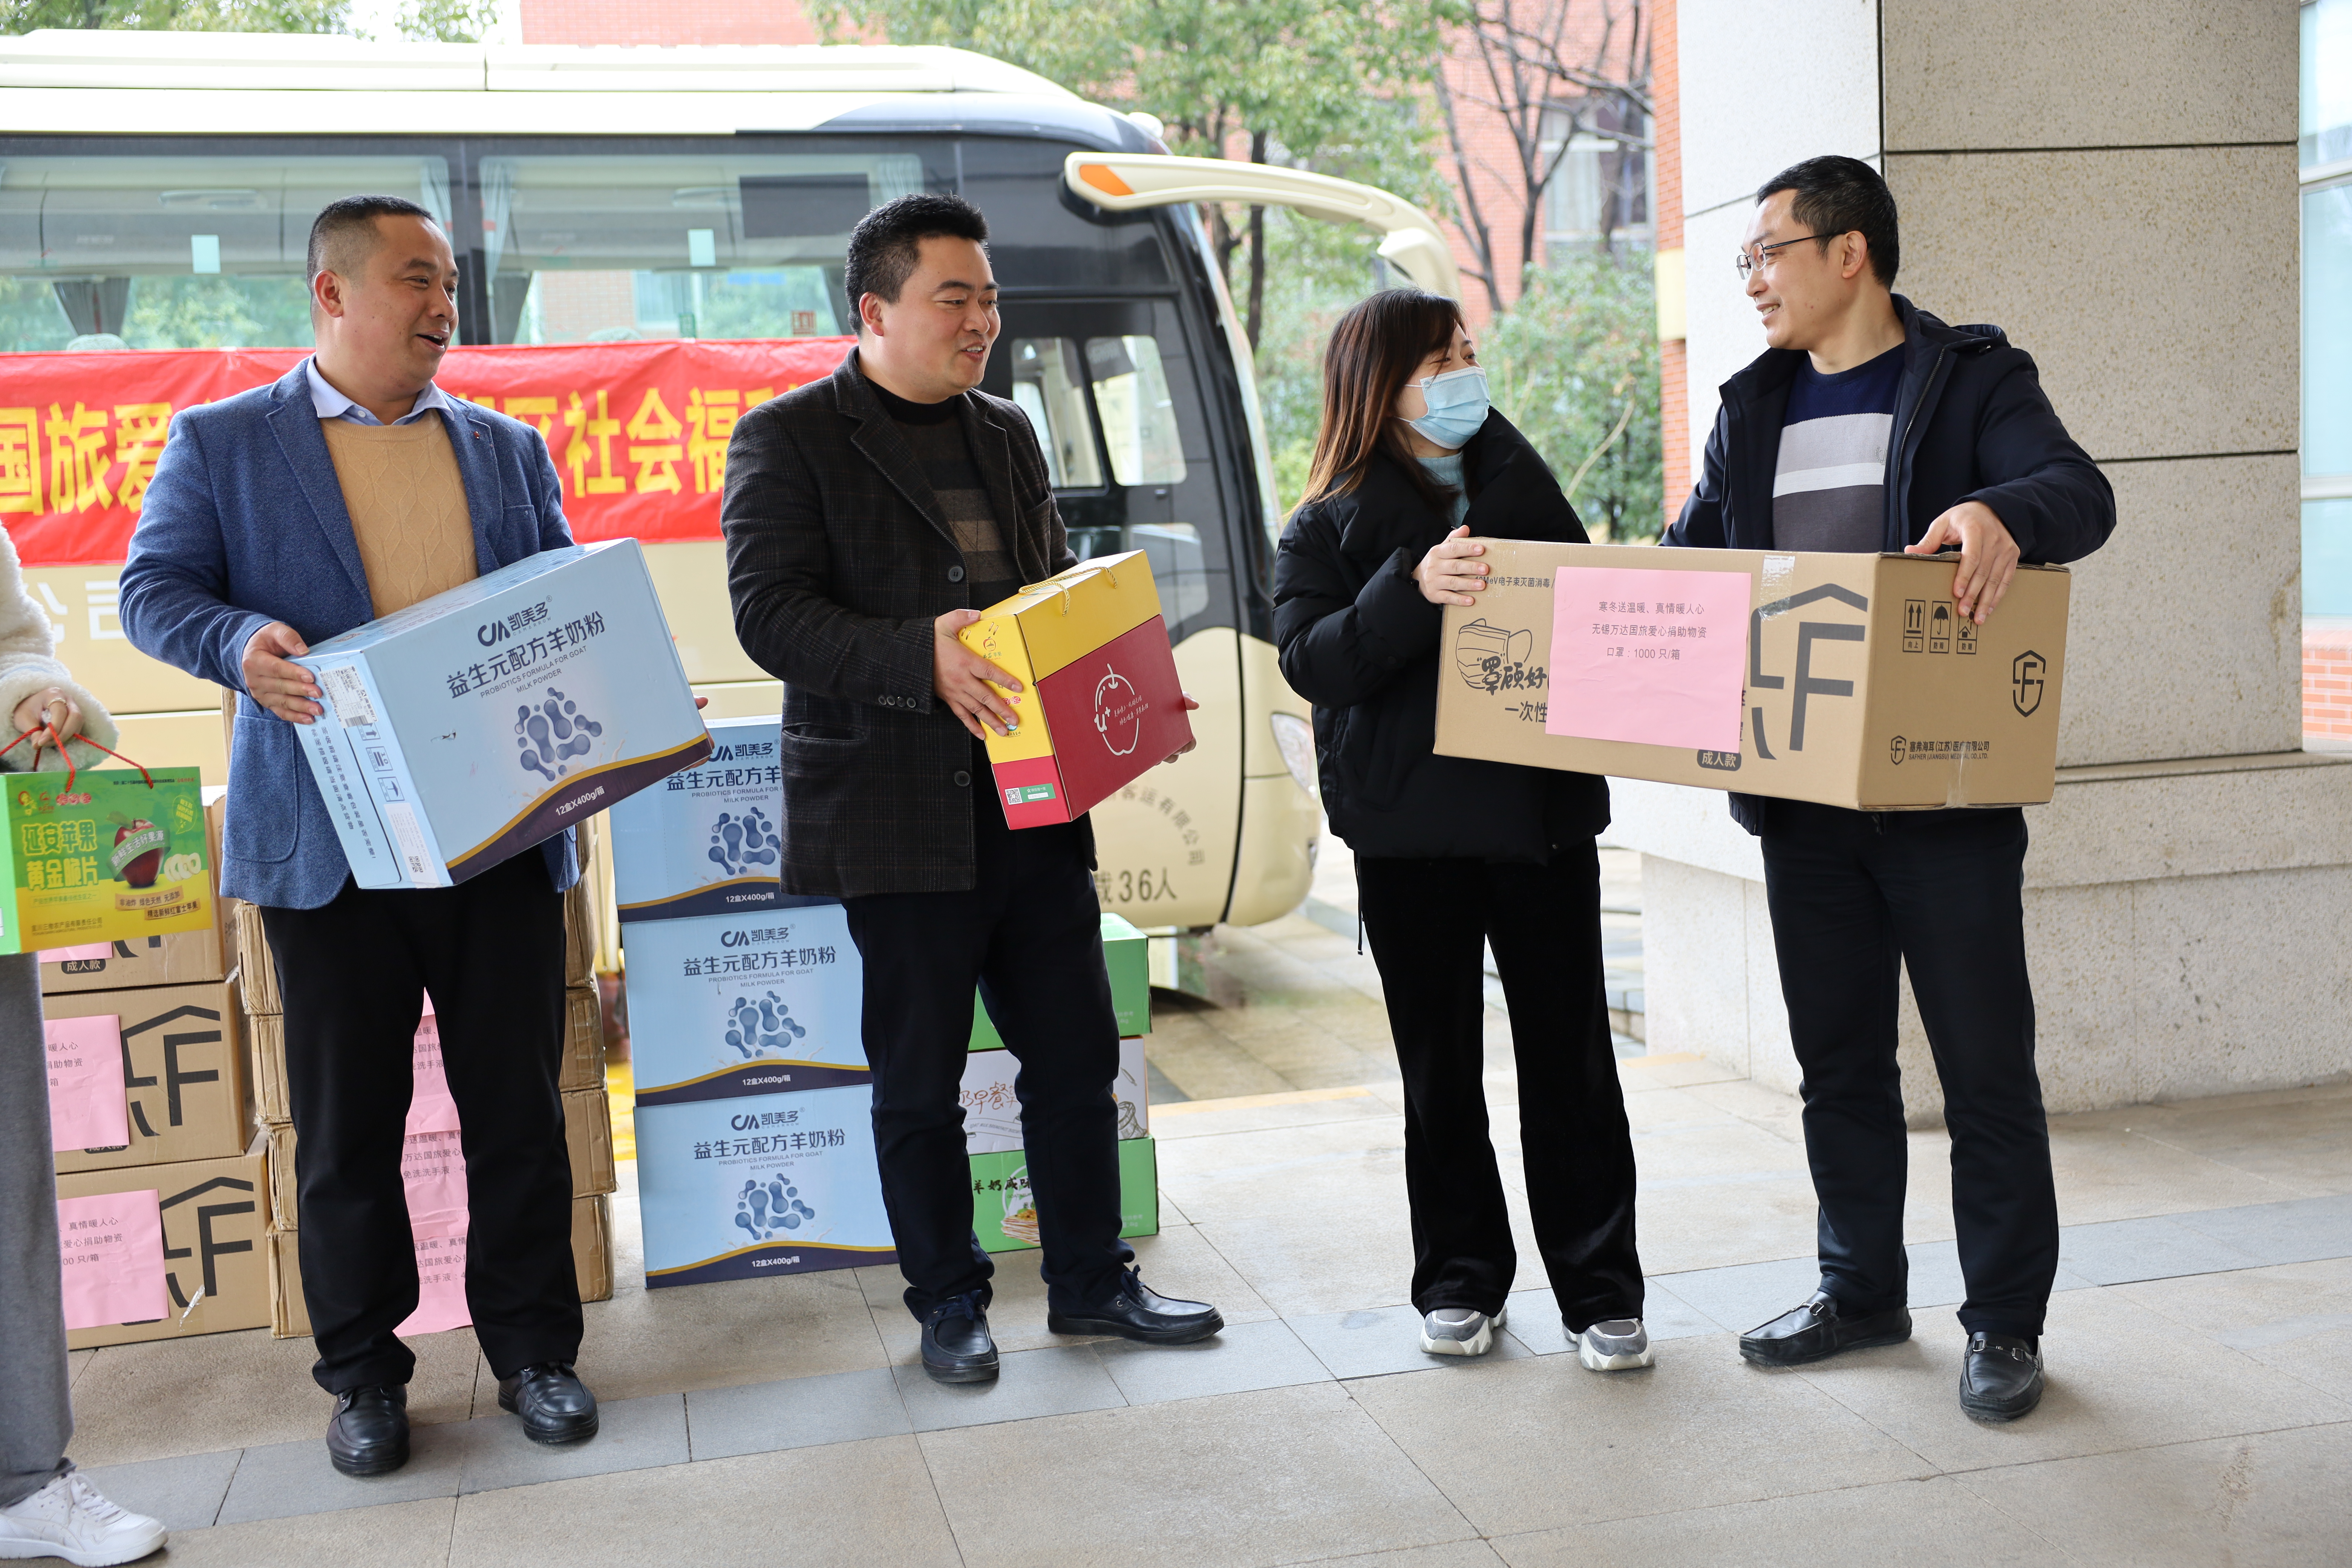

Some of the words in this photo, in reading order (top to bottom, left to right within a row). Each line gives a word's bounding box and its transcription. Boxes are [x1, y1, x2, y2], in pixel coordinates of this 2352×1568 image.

[1599, 601, 1704, 614] 寒冬送温暖、真情暖人心
[508, 602, 548, 631] 凯美多
[1592, 623, 1707, 638] 无锡万达国旅爱心捐助物资
[447, 611, 605, 698] 益生元配方羊奶粉
[1658, 648, 1680, 660] 只/箱
[480, 675, 522, 698] PROBIOTICS
[522, 661, 554, 680] FORMULA
[555, 654, 569, 667] FOR
[570, 645, 587, 658] GOAT
[516, 681, 533, 693] MILK
[533, 668, 562, 687] POWDER
[1505, 701, 1547, 723] 一次性
[735, 742, 774, 757] 凯美多
[1702, 751, 1736, 767] 成人款
[692, 790, 731, 798] PROBIOTICS
[21, 819, 98, 856] 延安苹果
[111, 830, 164, 867] 新鲜生活好果源
[26, 856, 99, 891] 黄金脆片
[119, 898, 137, 907] 非油炸
[139, 896, 162, 905] 绿色天然
[164, 891, 180, 903] 无添加
[147, 901, 198, 918] 精选新鲜红富士苹果
[751, 927, 789, 942] 凯美多
[66, 960, 101, 972] 成人款
[683, 945, 836, 977] 益生元配方羊奶粉
[708, 974, 748, 983] PROBIOTICS
[749, 971, 780, 980] FORMULA
[48, 1042, 78, 1052] 暖人心
[49, 1078, 59, 1087] 箱
[761, 1110, 798, 1125] 凯美多
[694, 1128, 845, 1160] 益生元配方羊奶粉
[718, 1157, 758, 1166] PROBIOTICS
[758, 1154, 790, 1162] FORMULA
[767, 1161, 795, 1170] POWDER
